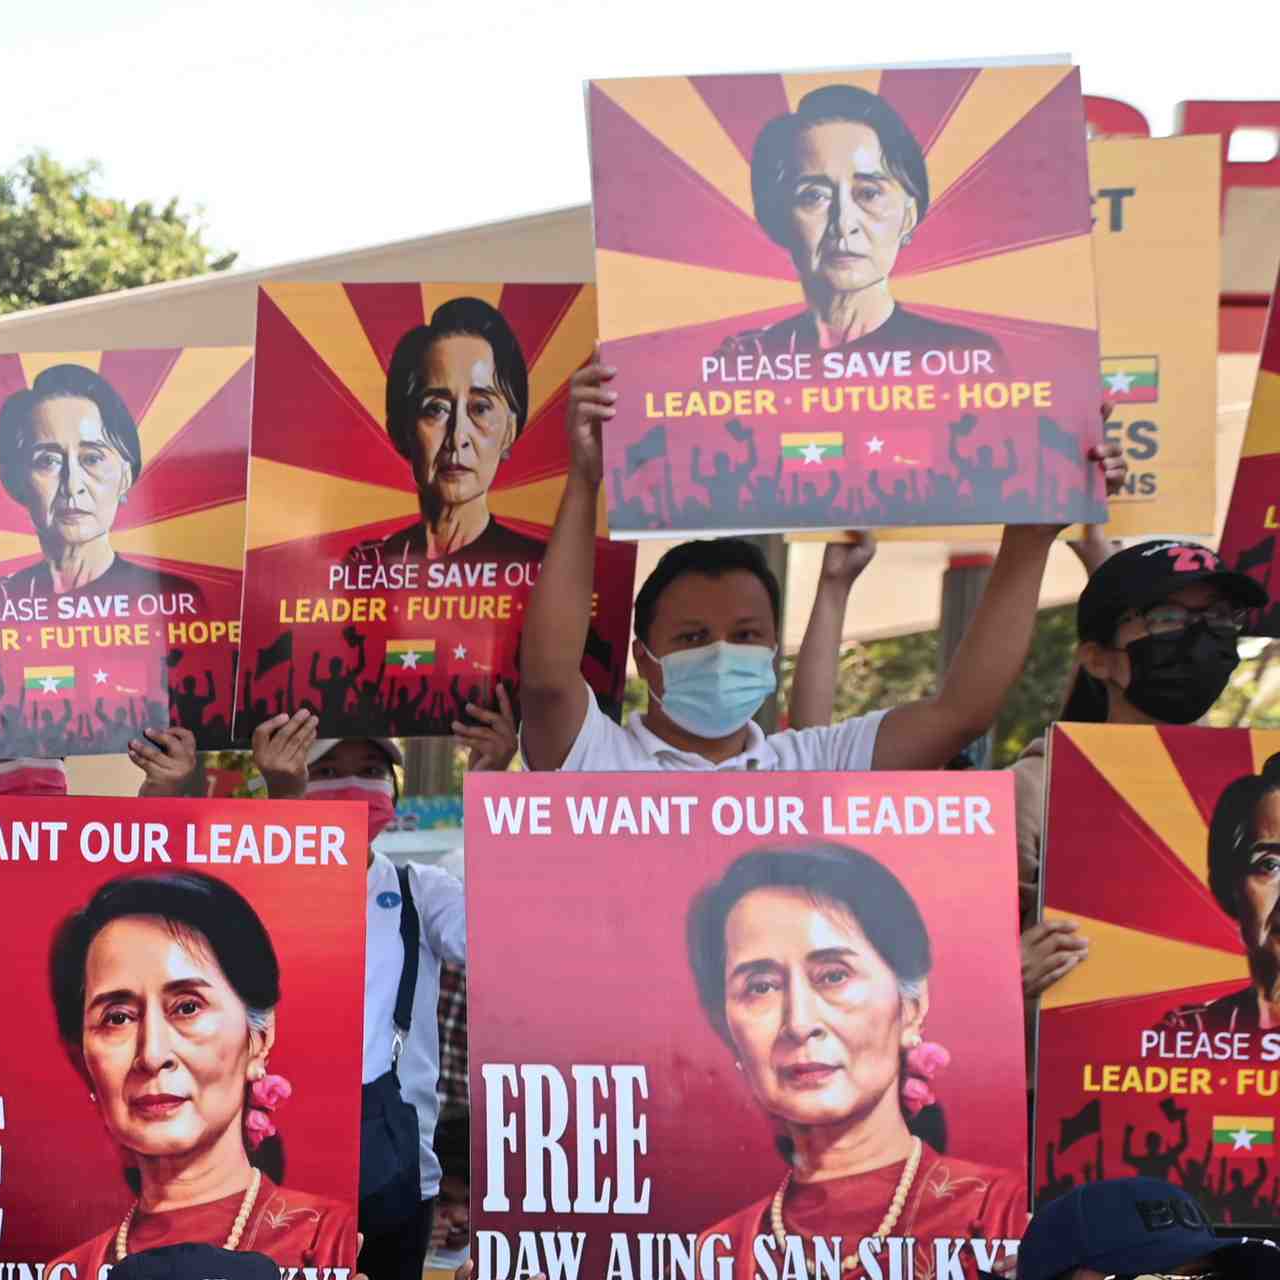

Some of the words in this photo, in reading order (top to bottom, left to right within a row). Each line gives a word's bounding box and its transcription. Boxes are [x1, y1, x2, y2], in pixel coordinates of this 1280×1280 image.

[701, 352, 813, 383] PLEASE
[822, 350, 911, 379] SAVE
[920, 347, 993, 375] OUR
[644, 386, 777, 419] LEADER
[801, 382, 936, 413] FUTURE
[957, 379, 1052, 409] HOPE
[328, 564, 420, 591] PLEASE
[427, 562, 497, 589] SAVE
[504, 562, 542, 586] OU
[57, 594, 130, 619] SAVE
[137, 593, 197, 616] OUR
[278, 597, 387, 624] LEADER
[406, 594, 512, 621] FUTURE
[40, 623, 150, 649] FUTURE
[167, 620, 241, 645] HOPE
[483, 796, 552, 836] WE
[565, 796, 699, 836] WANT
[711, 795, 809, 836] OUR
[821, 796, 996, 836] LEADER
[79, 821, 172, 864] OUR
[185, 823, 349, 866] LEADER
[1140, 1031, 1250, 1060] PLEASE
[1083, 1065, 1213, 1094] LEADER
[481, 1063, 652, 1216] FREE
